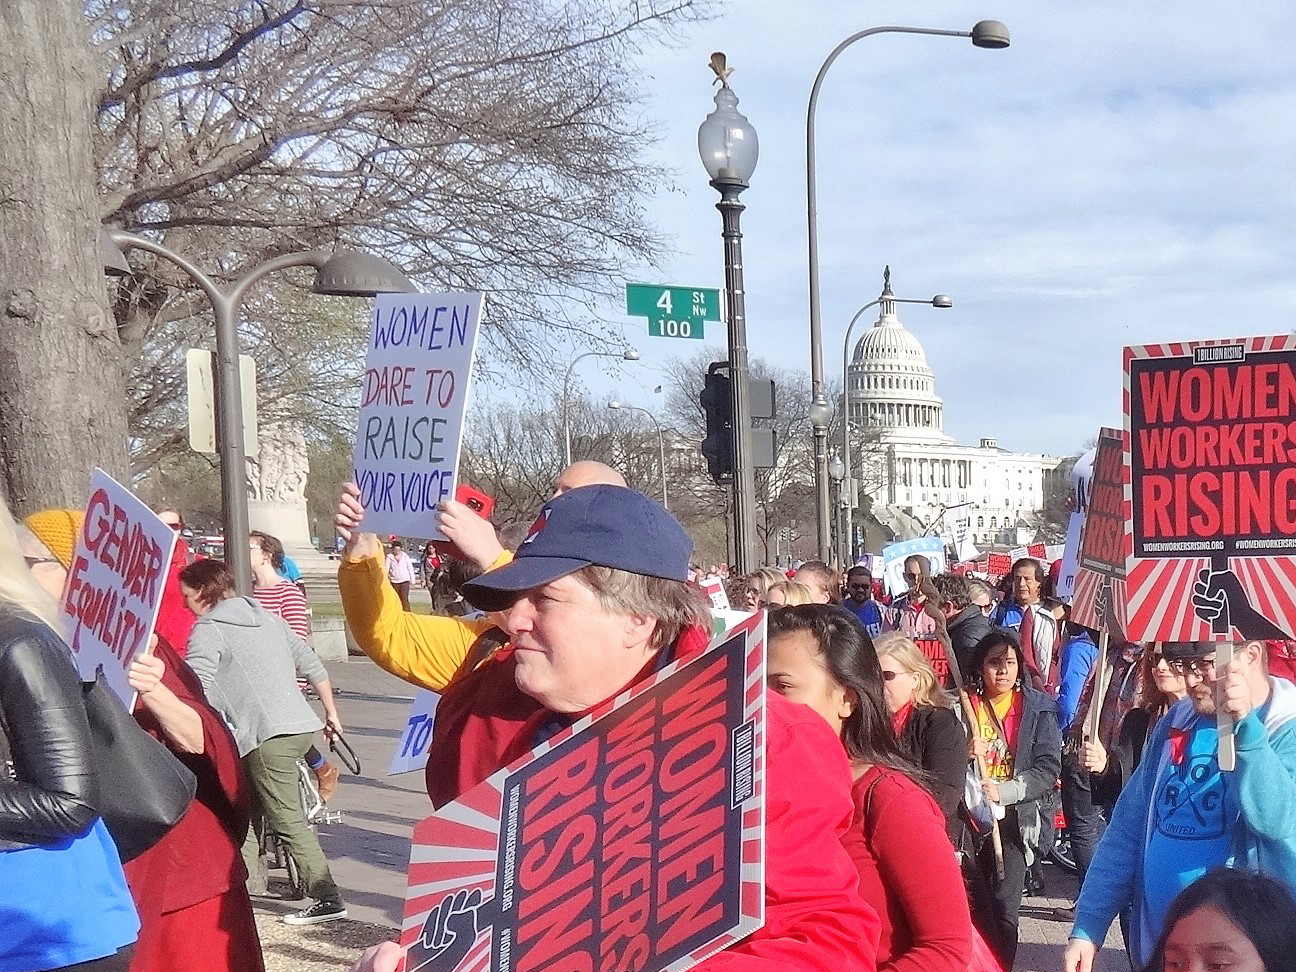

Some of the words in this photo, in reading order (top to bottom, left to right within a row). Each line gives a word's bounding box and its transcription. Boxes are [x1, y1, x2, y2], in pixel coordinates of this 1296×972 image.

[656, 290, 673, 314] 4
[692, 292, 705, 304] St
[374, 304, 470, 351] WOMEN
[659, 319, 691, 338] 100
[361, 366, 416, 408] DARE
[425, 369, 455, 409] TO
[364, 416, 448, 464] RAISE
[354, 469, 396, 513] YOUR
[400, 470, 453, 513] VOICE
[83, 488, 163, 609] GENDER
[400, 713, 433, 758] TO
[656, 655, 728, 955] WOMEN
